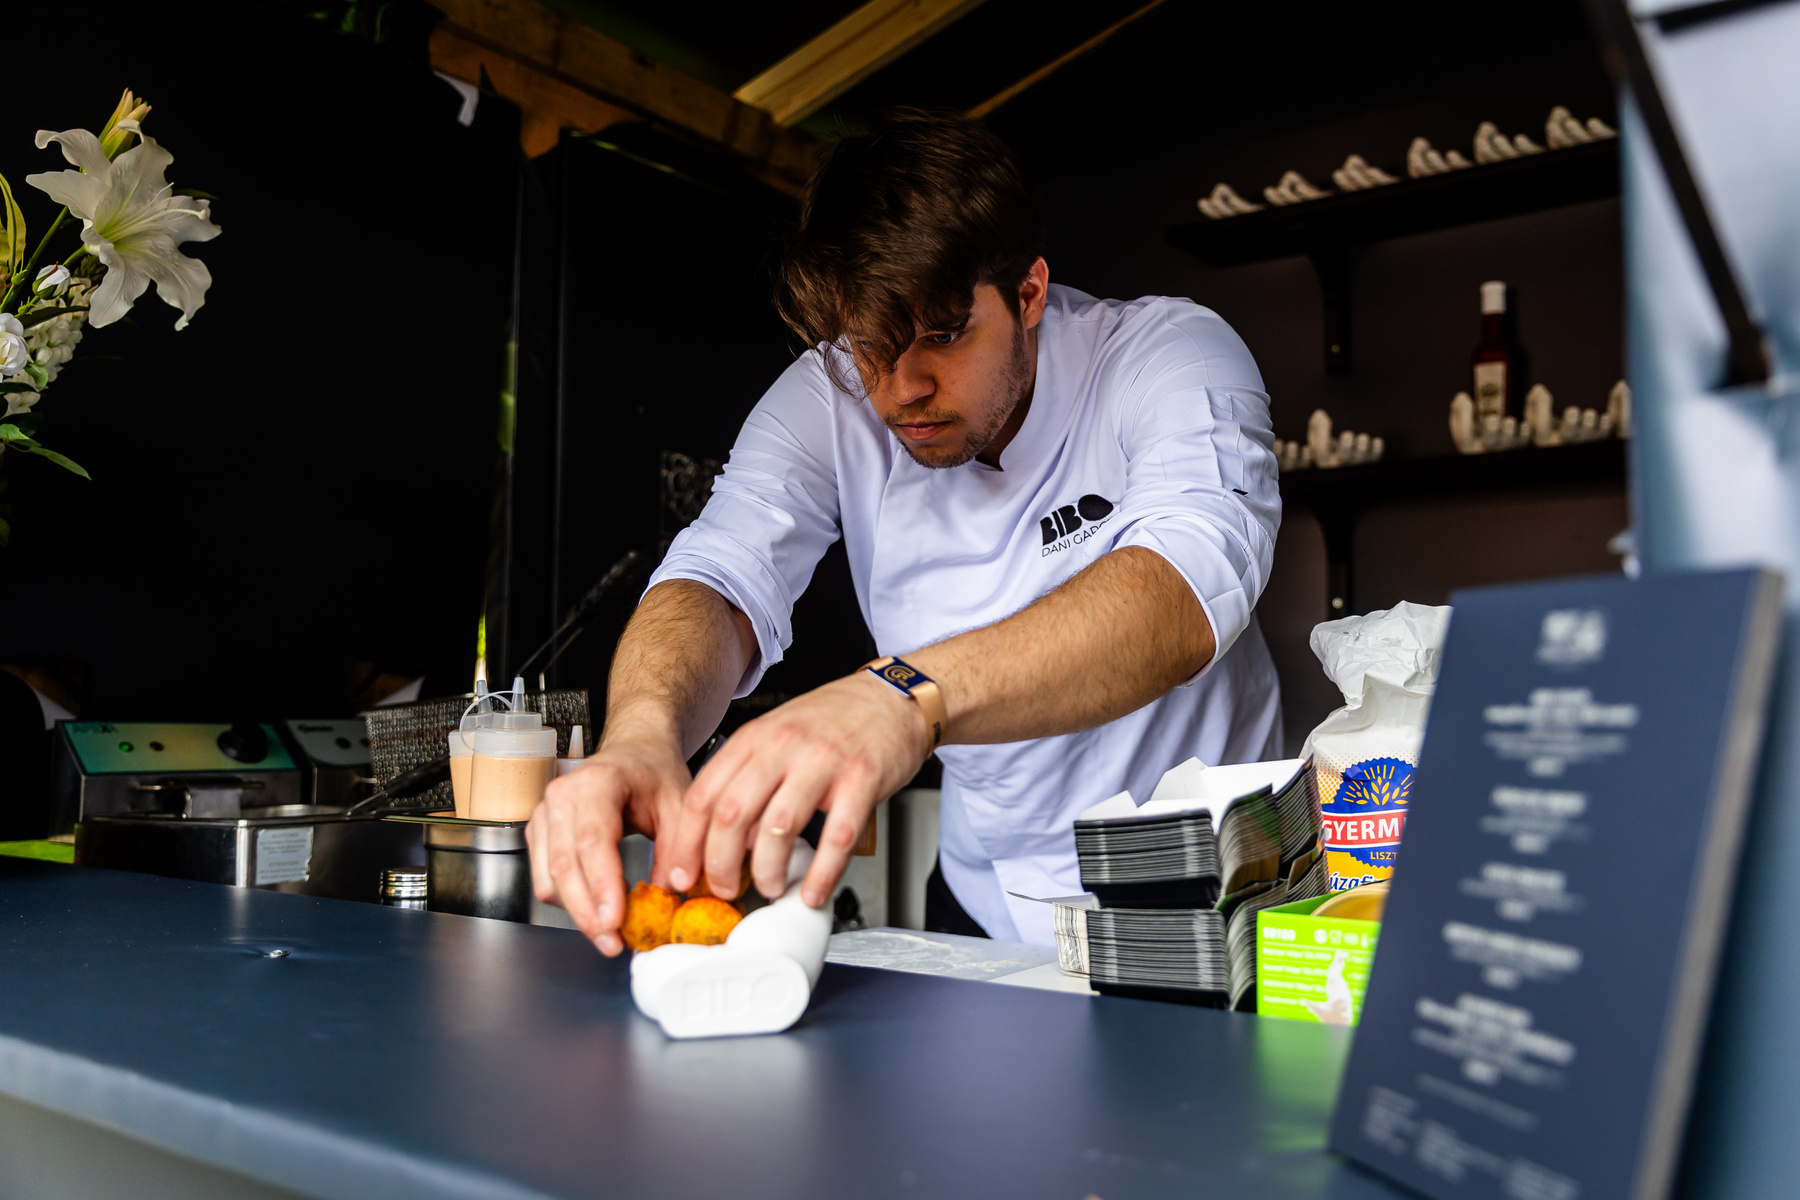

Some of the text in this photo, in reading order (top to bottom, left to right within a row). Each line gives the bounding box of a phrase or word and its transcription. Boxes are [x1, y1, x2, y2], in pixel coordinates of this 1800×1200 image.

[1040, 494, 1114, 546] BIBO
[1042, 539, 1071, 557] DANI
[1322, 817, 1407, 841] GYERM
[1370, 851, 1398, 861] LISZT
